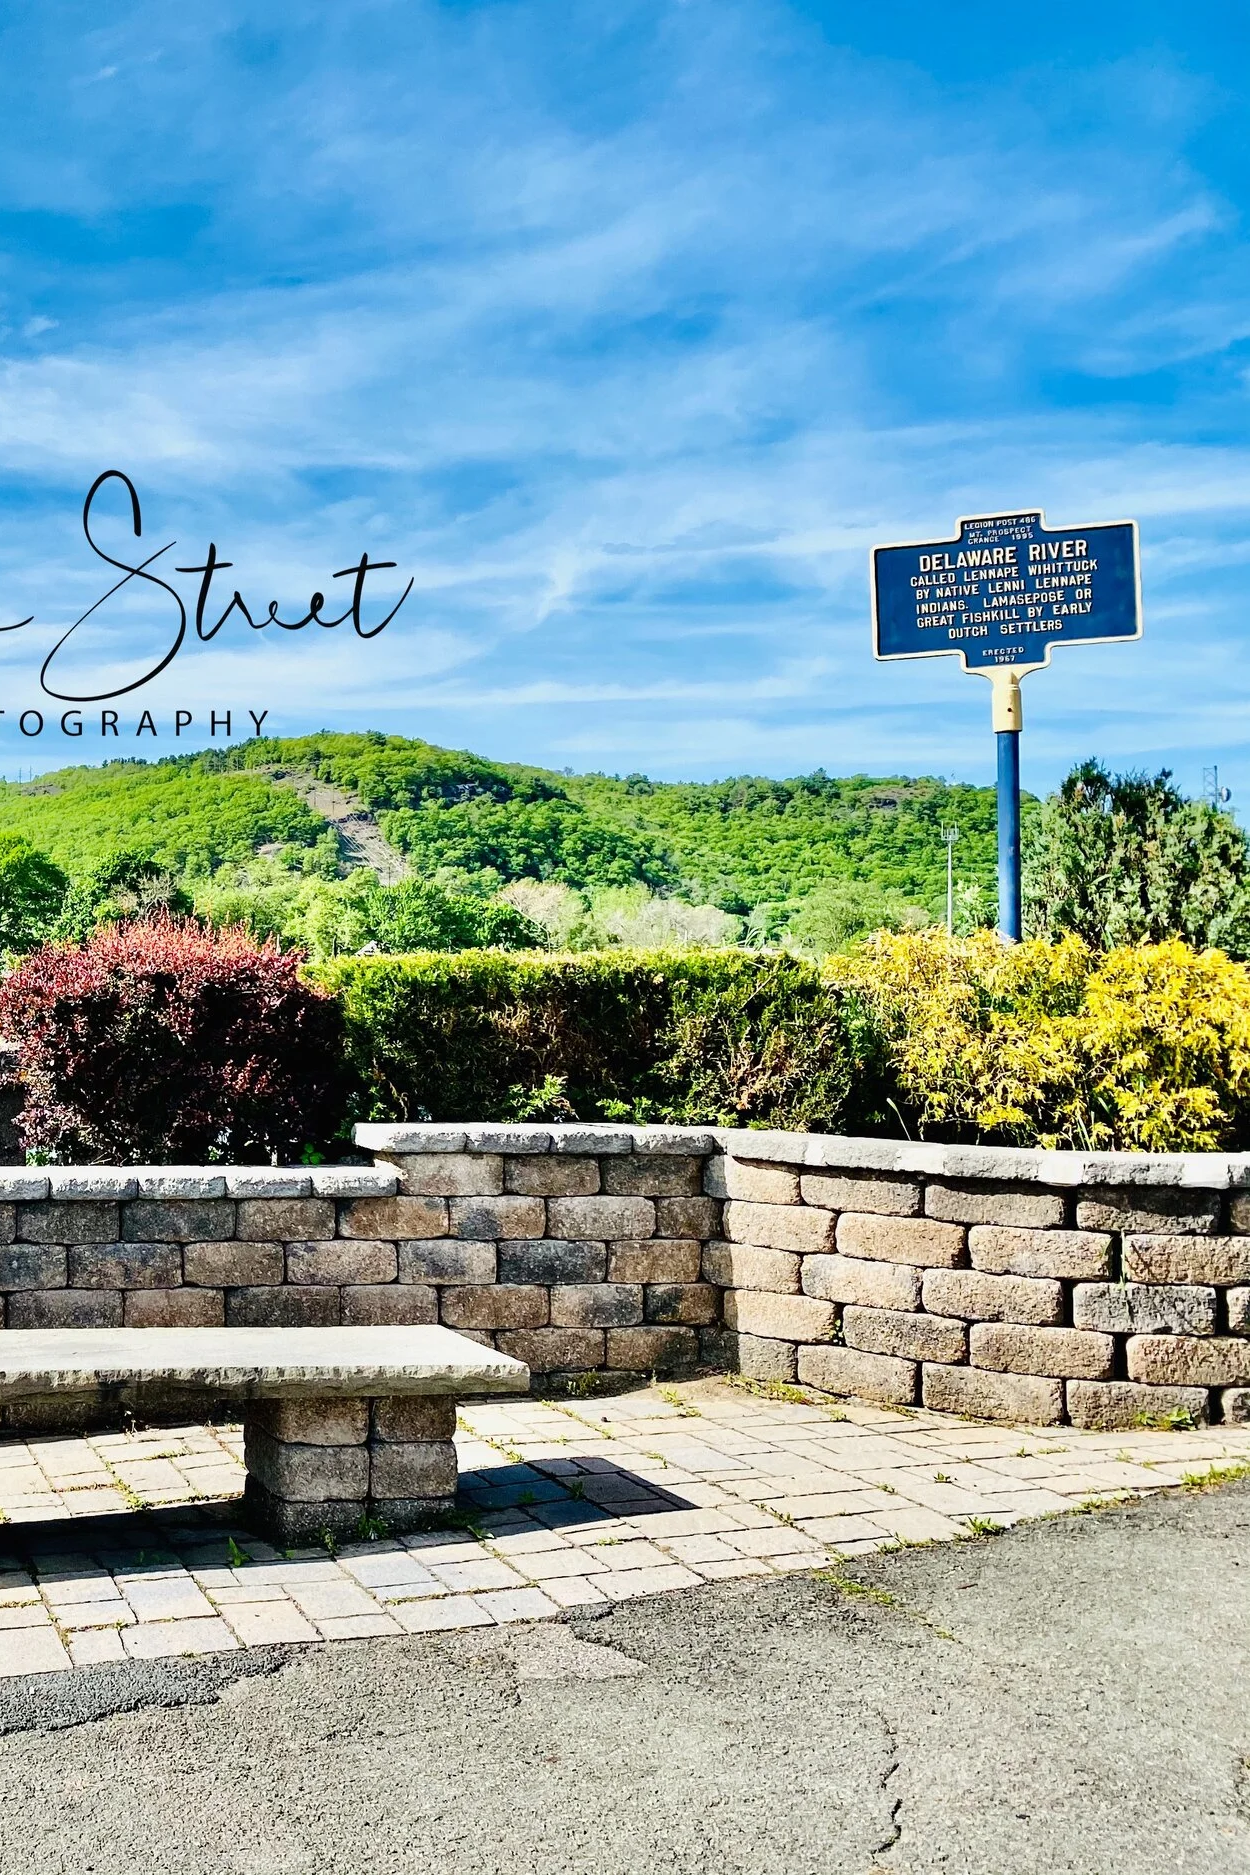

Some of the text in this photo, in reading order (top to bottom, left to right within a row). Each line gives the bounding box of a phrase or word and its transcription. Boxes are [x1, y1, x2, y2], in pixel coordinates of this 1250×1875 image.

[987, 525, 1032, 537] PROSPECT
[996, 518, 1017, 527] POST
[919, 539, 1087, 572] DELAWARE RIVER
[910, 559, 1098, 587] CALLED LENNAPE WIHITTUCK
[916, 574, 1092, 600] BY NATIVE LENNI LENNAPE
[916, 588, 1092, 614] INDIANS. LAMASEPOSE OR
[916, 602, 1092, 628] GREAT FISHKILL BY EARLY
[948, 619, 1063, 639] DUTCH SETTLERS
[982, 646, 1024, 656] ERECTED
[994, 655, 1015, 663] 1967
